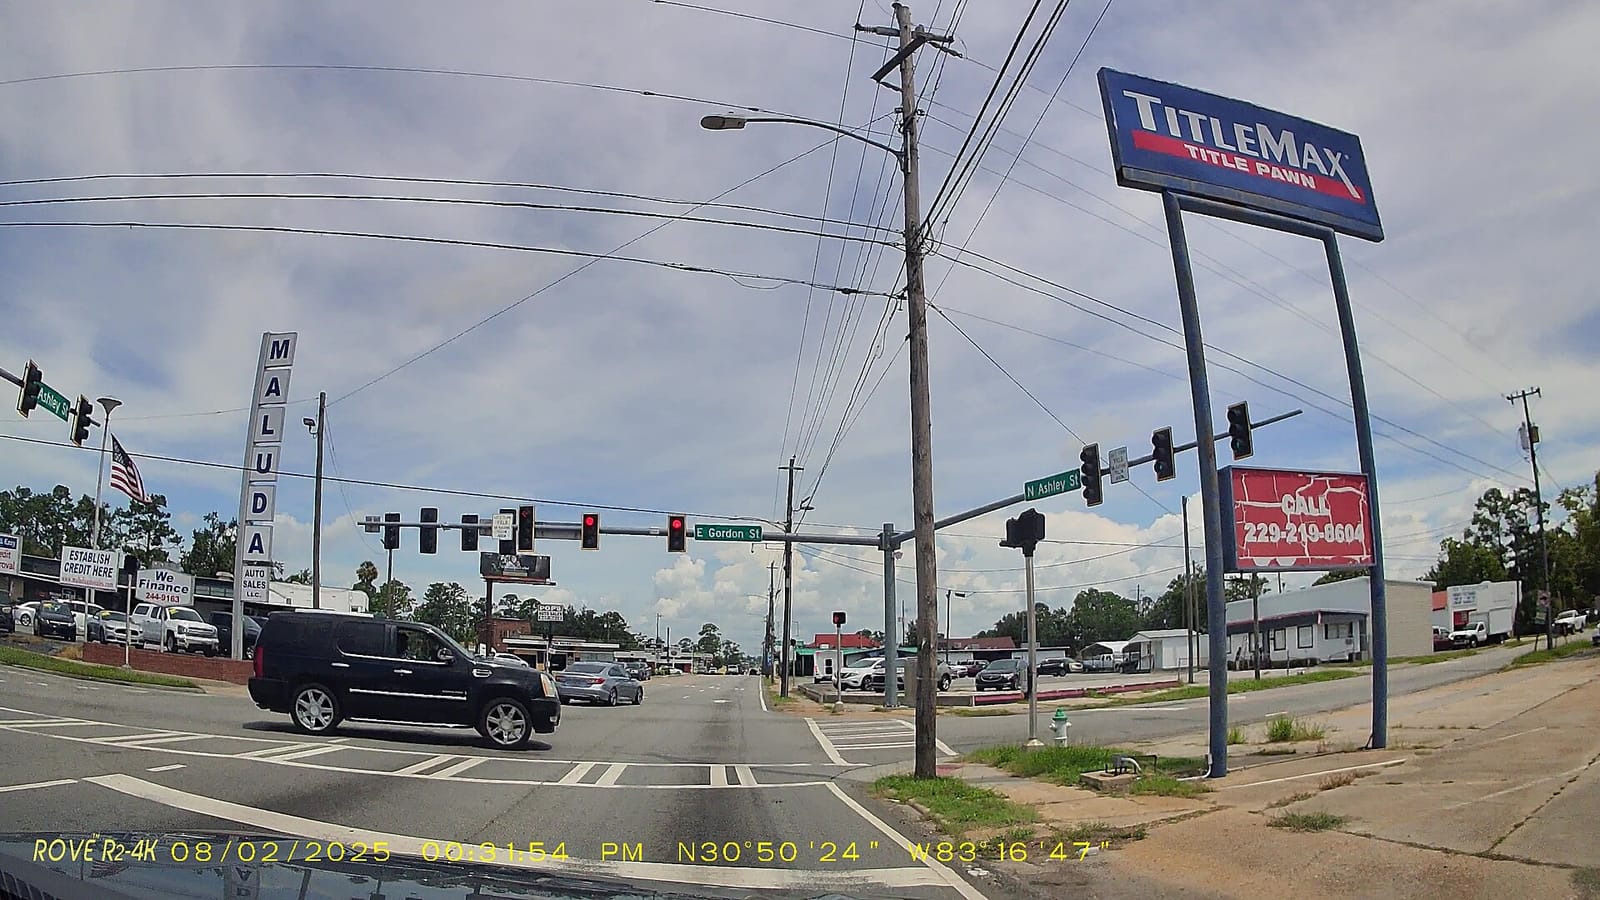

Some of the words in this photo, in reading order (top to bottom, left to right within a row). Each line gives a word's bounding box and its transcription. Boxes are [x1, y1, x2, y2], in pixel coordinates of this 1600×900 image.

[1183, 143, 1249, 172] TITLE
[1256, 161, 1316, 189] PAWN
[38, 387, 60, 414] Ashley
[1027, 486, 1035, 498] N
[1038, 479, 1066, 495] Ashley
[1069, 473, 1079, 487] St
[1281, 494, 1331, 516] CALL
[696, 527, 703, 538] E
[708, 528, 744, 538] Gordon
[749, 528, 760, 539] St
[1244, 522, 1363, 543] 229-219-8604
[69, 550, 111, 565] ESTABLISH
[64, 562, 91, 575] CREDIT
[93, 565, 114, 578] HERE
[155, 571, 175, 583] We
[244, 569, 265, 578] AUTO
[139, 579, 189, 594] Finance
[242, 580, 266, 589] SALES
